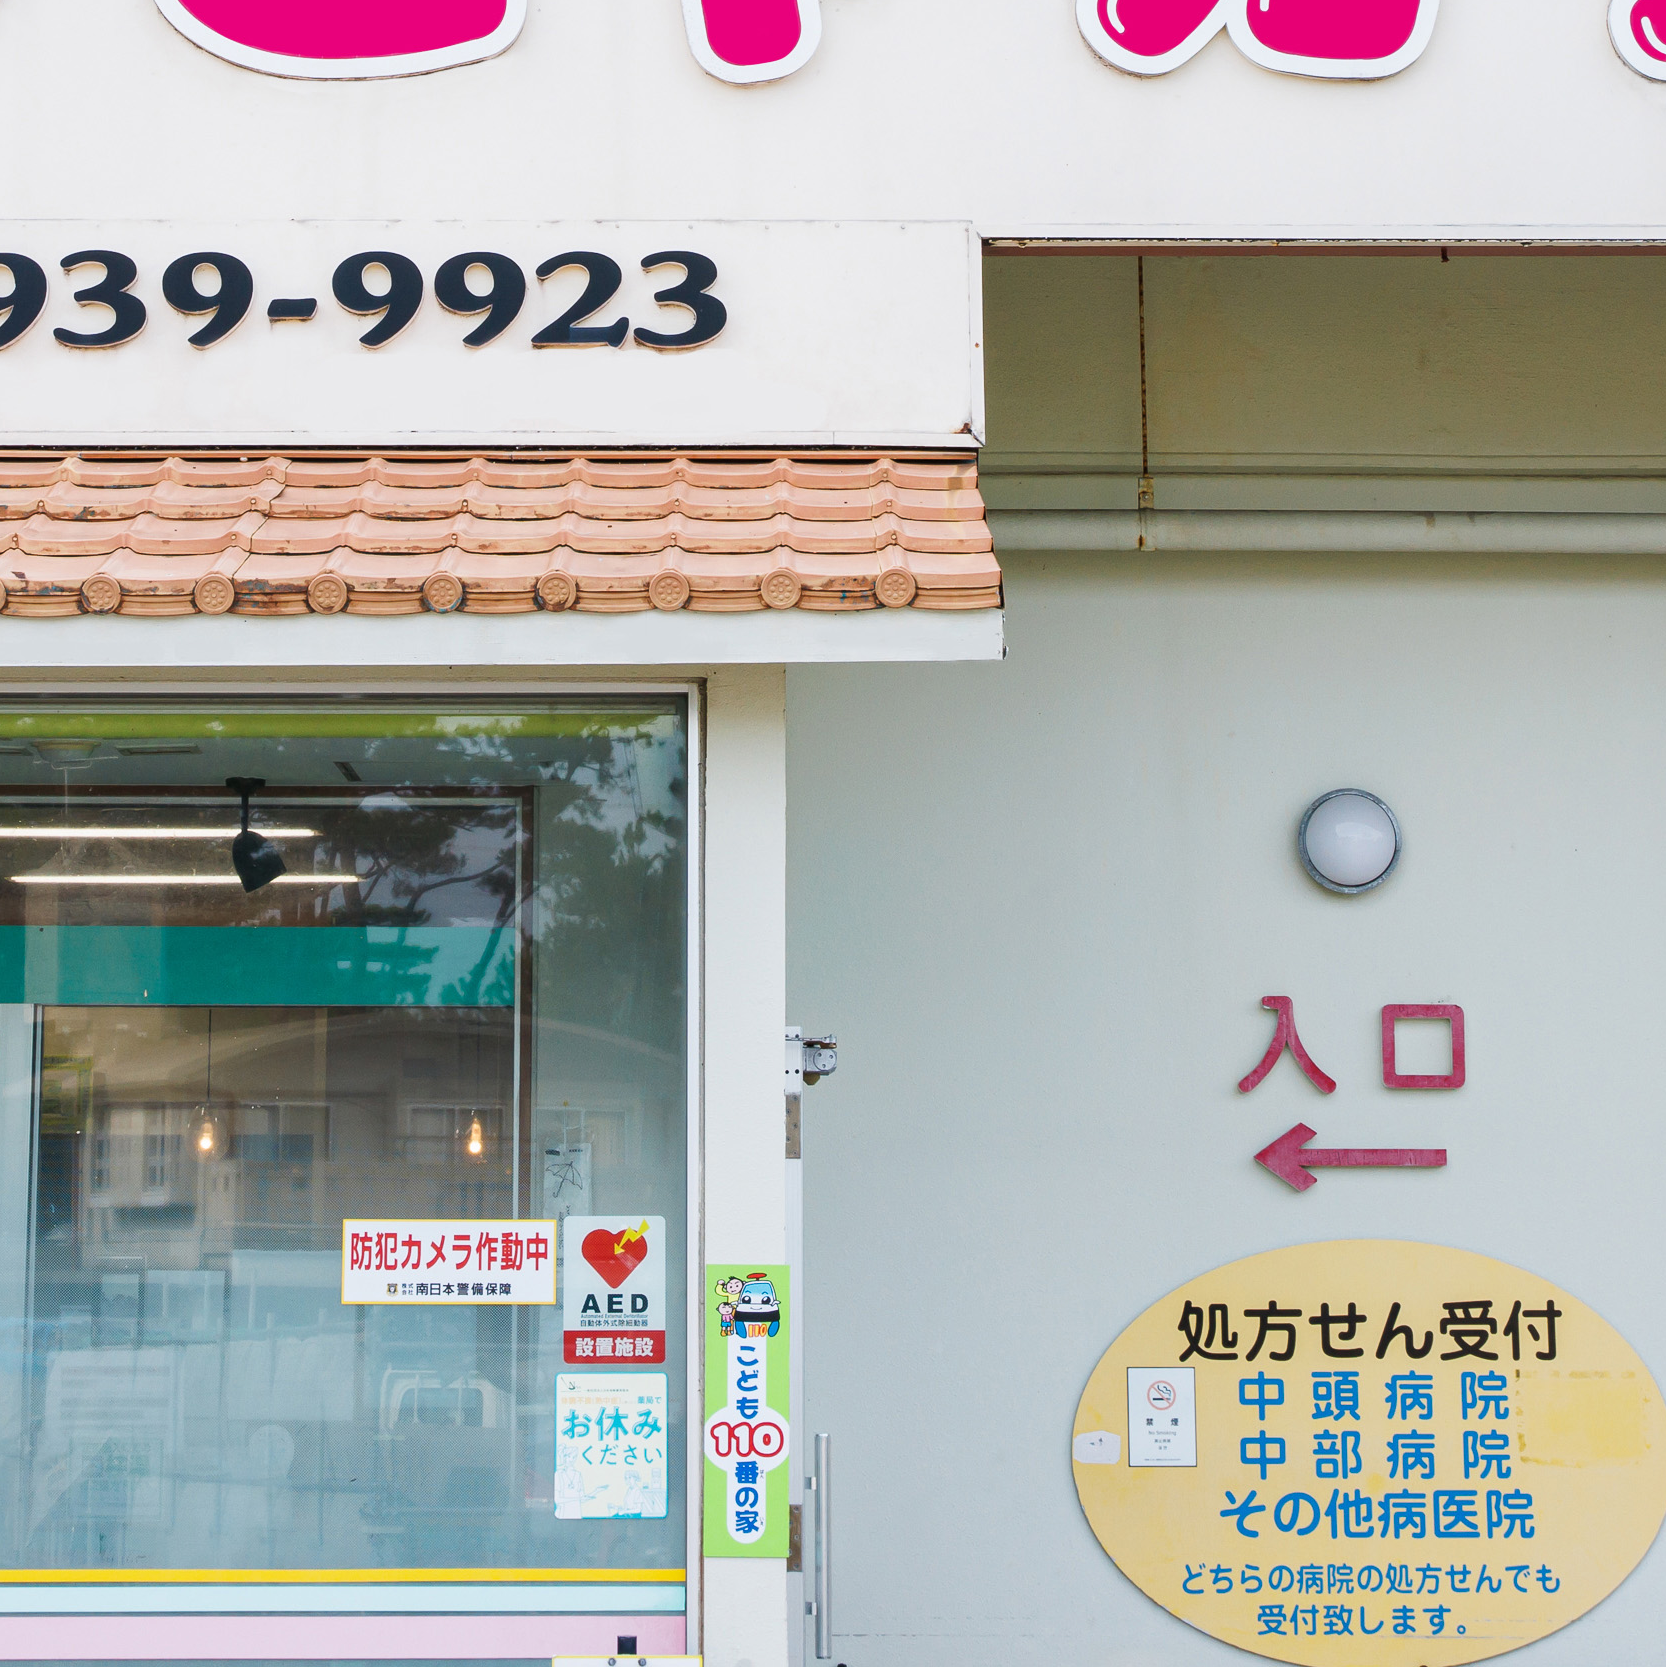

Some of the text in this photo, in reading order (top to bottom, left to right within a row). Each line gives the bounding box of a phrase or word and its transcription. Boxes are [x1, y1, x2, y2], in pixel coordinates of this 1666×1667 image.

[1237, 995, 1466, 1095] 入口
[350, 1232, 548, 1271] 防犯カメラ作動中
[416, 1282, 512, 1296] 南日本警備保障
[581, 1294, 648, 1313] AED
[580, 1319, 648, 1327] 自動体外式除細動器
[748, 1323, 768, 1337] 110
[1177, 1299, 1563, 1363] 処方せん受付
[575, 1337, 654, 1357] 設置施設
[1238, 1370, 1510, 1421] 中頭病院
[561, 1406, 662, 1442] お休み
[581, 1444, 663, 1466] ください
[1240, 1429, 1512, 1480] 中部病院
[1219, 1488, 1535, 1540] その他病医院
[1182, 1563, 1561, 1595] どちらの病院の処方せんでも
[1257, 1604, 1470, 1637] 受付致します。
